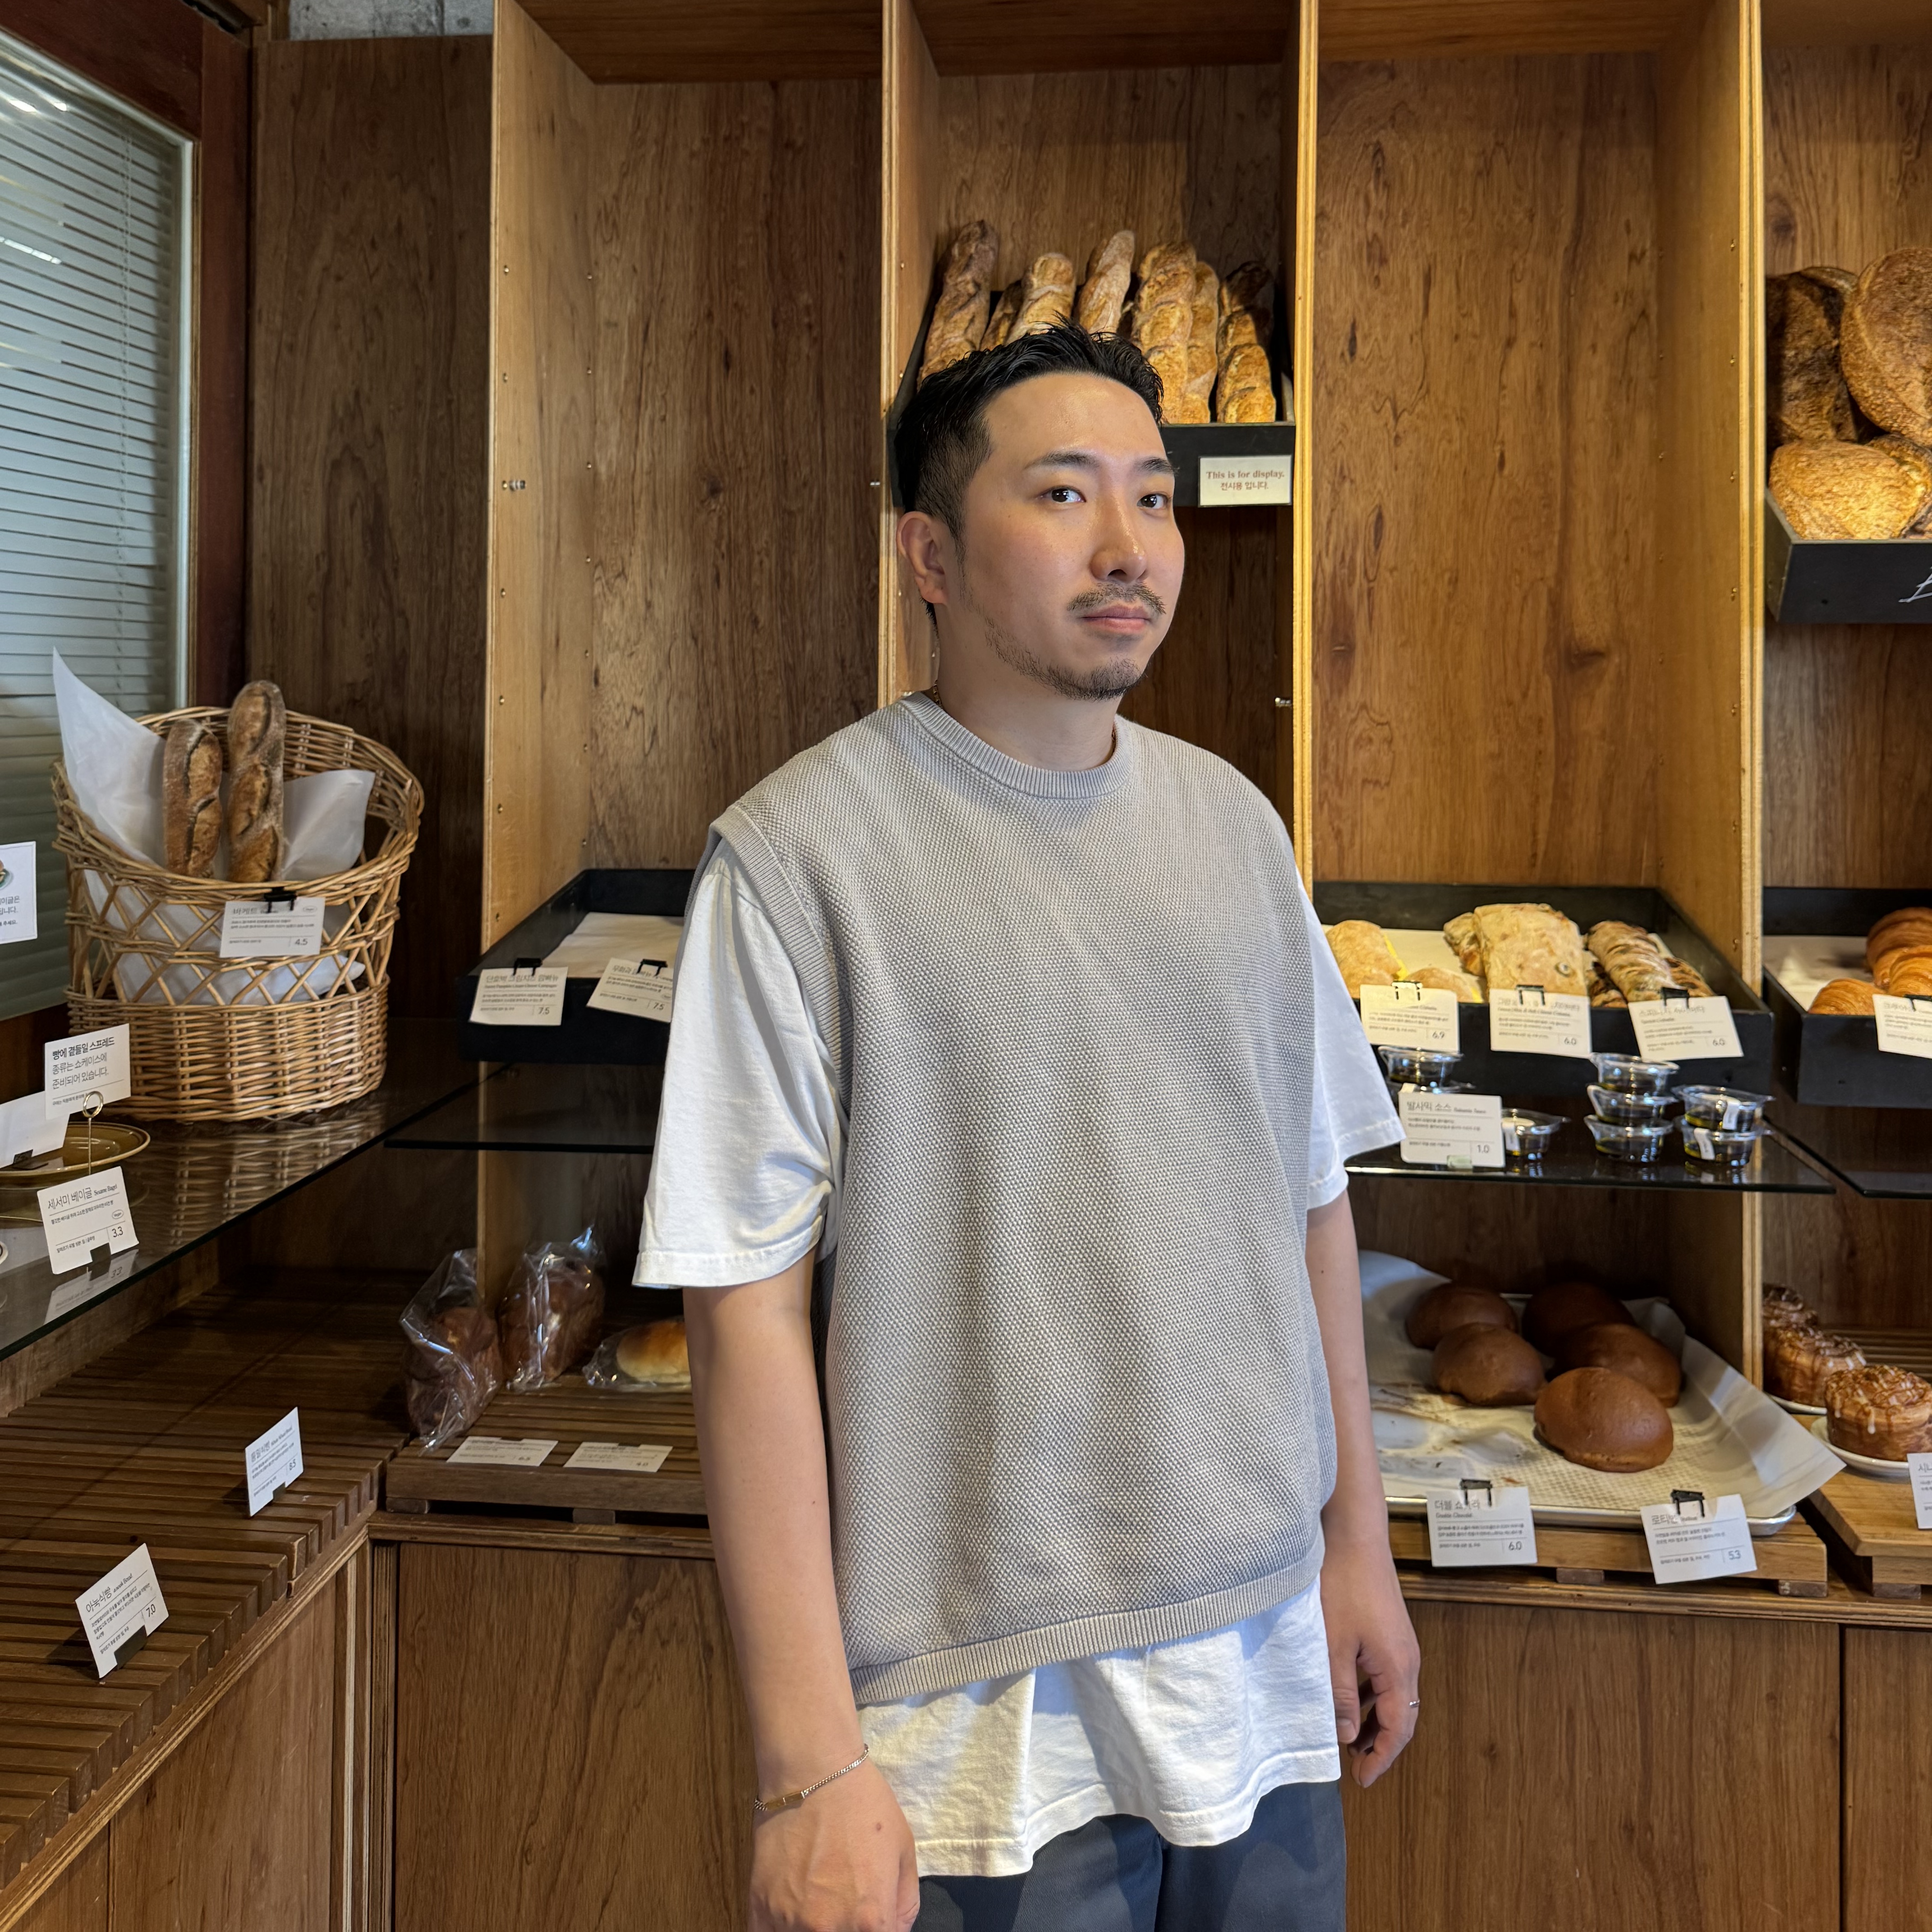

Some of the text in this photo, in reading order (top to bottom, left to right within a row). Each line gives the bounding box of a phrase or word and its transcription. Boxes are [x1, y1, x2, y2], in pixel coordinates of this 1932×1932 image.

[1206, 471, 1225, 479] This
[1238, 470, 1250, 478] for
[1253, 470, 1284, 479] display.
[1220, 482, 1269, 491] 전시용 입니다.
[653, 1002, 665, 1010] 7.5
[1564, 1037, 1577, 1045] 6.0
[52, 1037, 115, 1060] 빵에 곁들일 스프레드
[53, 1053, 107, 1075] 종류는 쇼케이스에
[53, 1067, 109, 1090] 준비되어 있습니다.
[1407, 1101, 1452, 1112] 발사믹 소스
[1477, 1145, 1490, 1153] 1.0
[48, 1187, 92, 1210] 세서미 베이글
[111, 1226, 123, 1238] 3.3
[1435, 1500, 1452, 1510] 더블
[1509, 1541, 1523, 1550] 6.0
[1728, 1550, 1741, 1560] 5.3
[146, 1604, 156, 1618] 7.0
